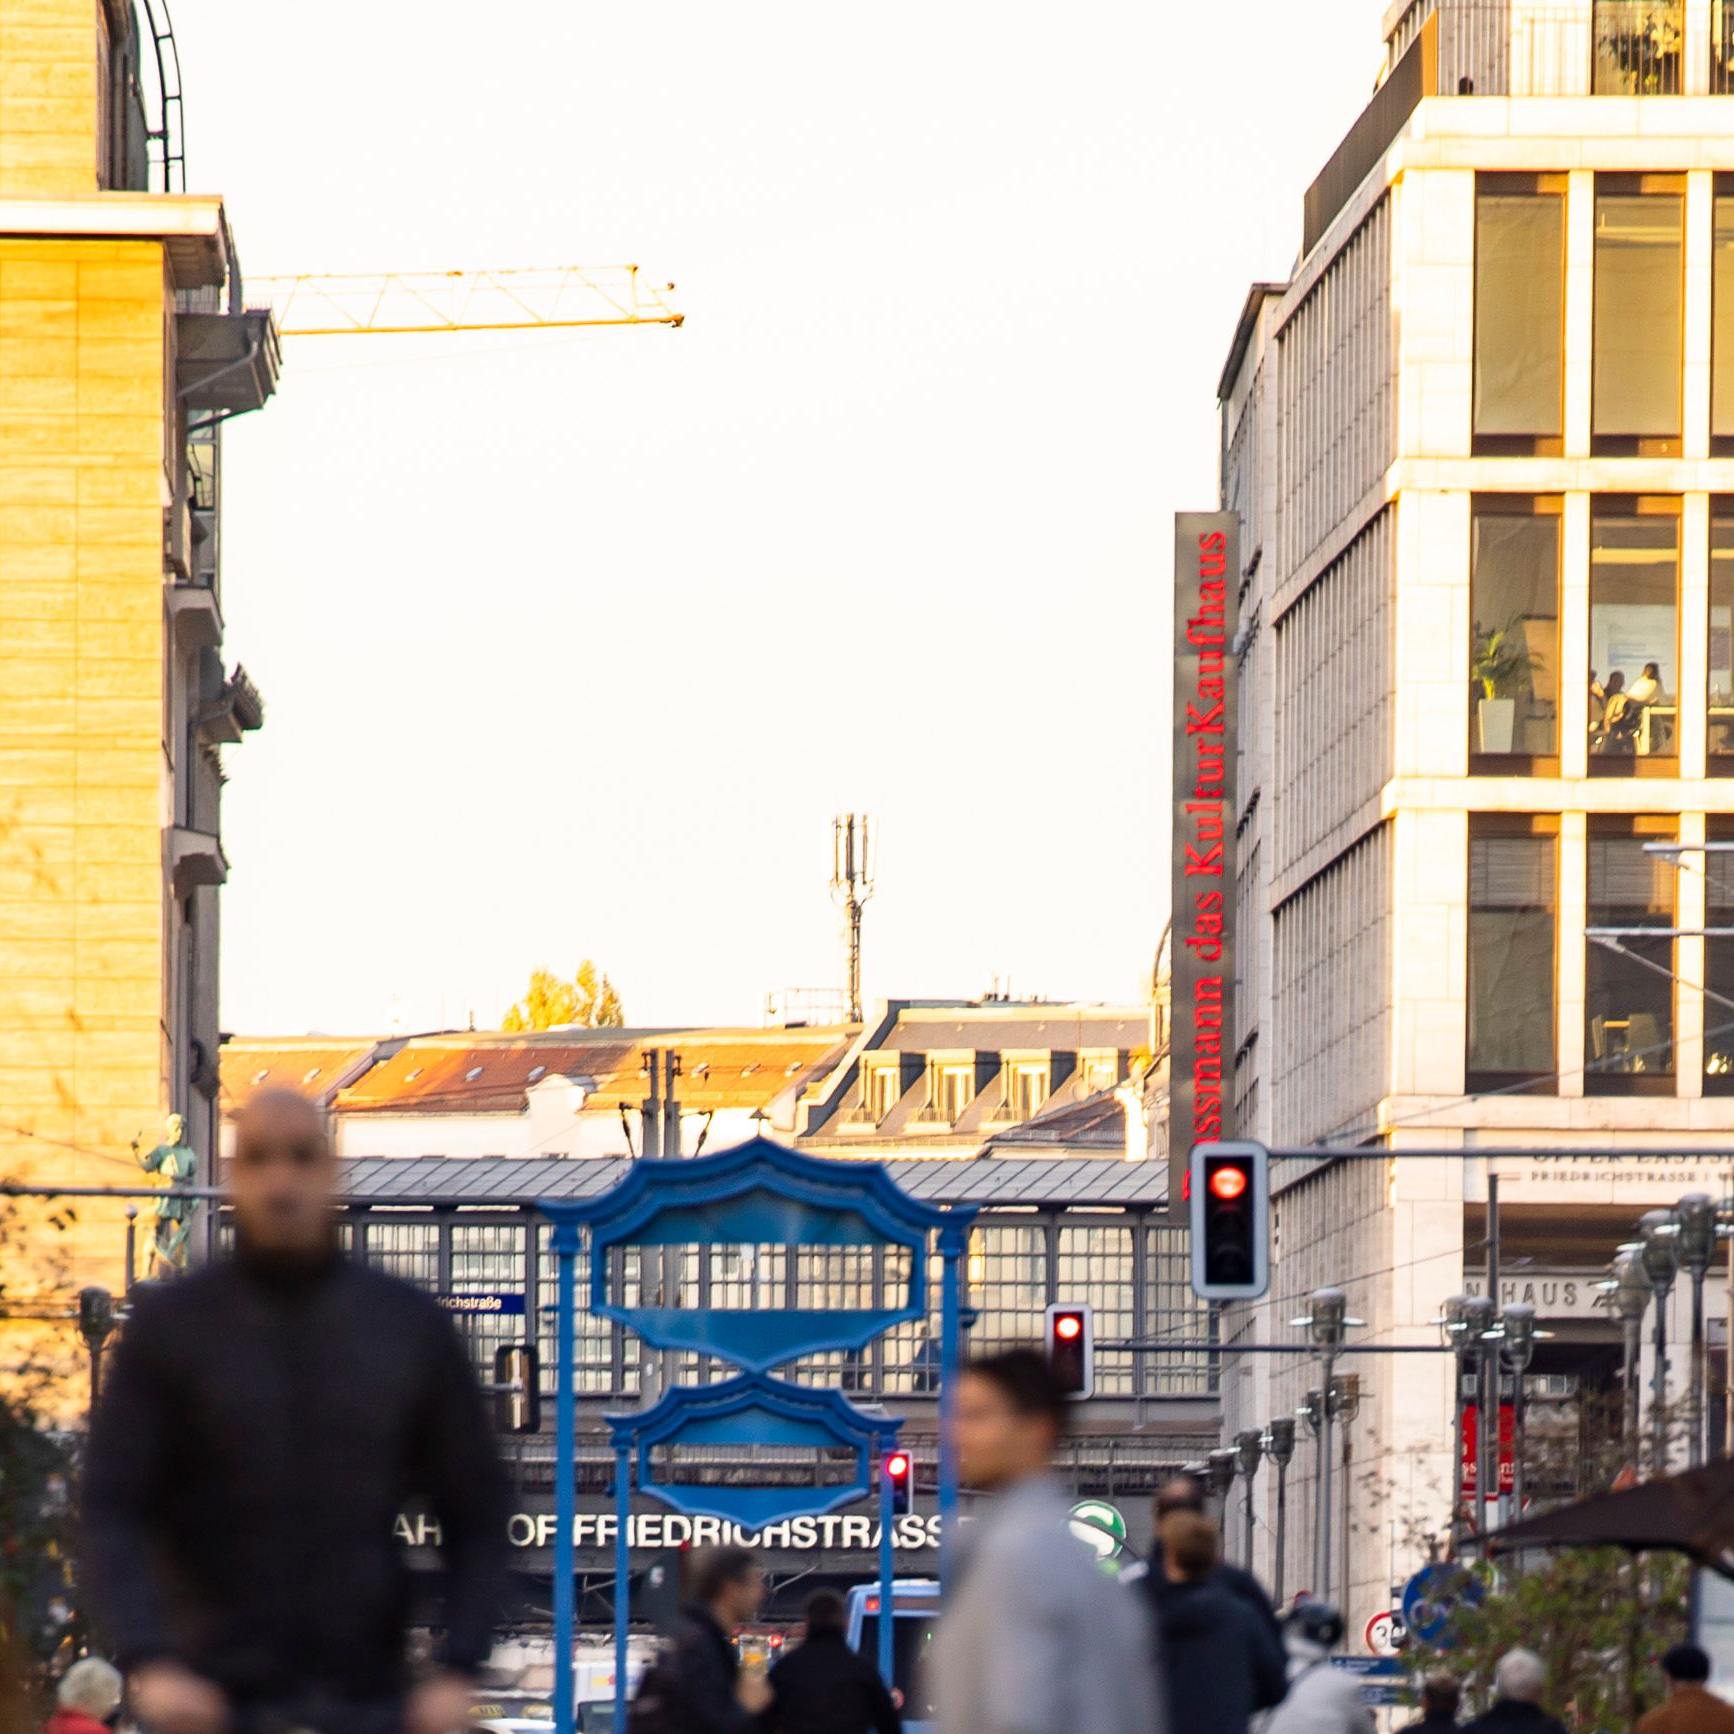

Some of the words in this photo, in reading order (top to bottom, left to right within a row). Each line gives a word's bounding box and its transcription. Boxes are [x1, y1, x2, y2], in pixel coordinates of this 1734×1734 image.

[1184, 531, 1226, 877] KulturKaufhaus
[1185, 890, 1223, 962] das
[1181, 975, 1222, 1200] ssmann
[1501, 1282, 1578, 1307] HAUS
[573, 1513, 973, 1549] FRIEDRICHSTRASS
